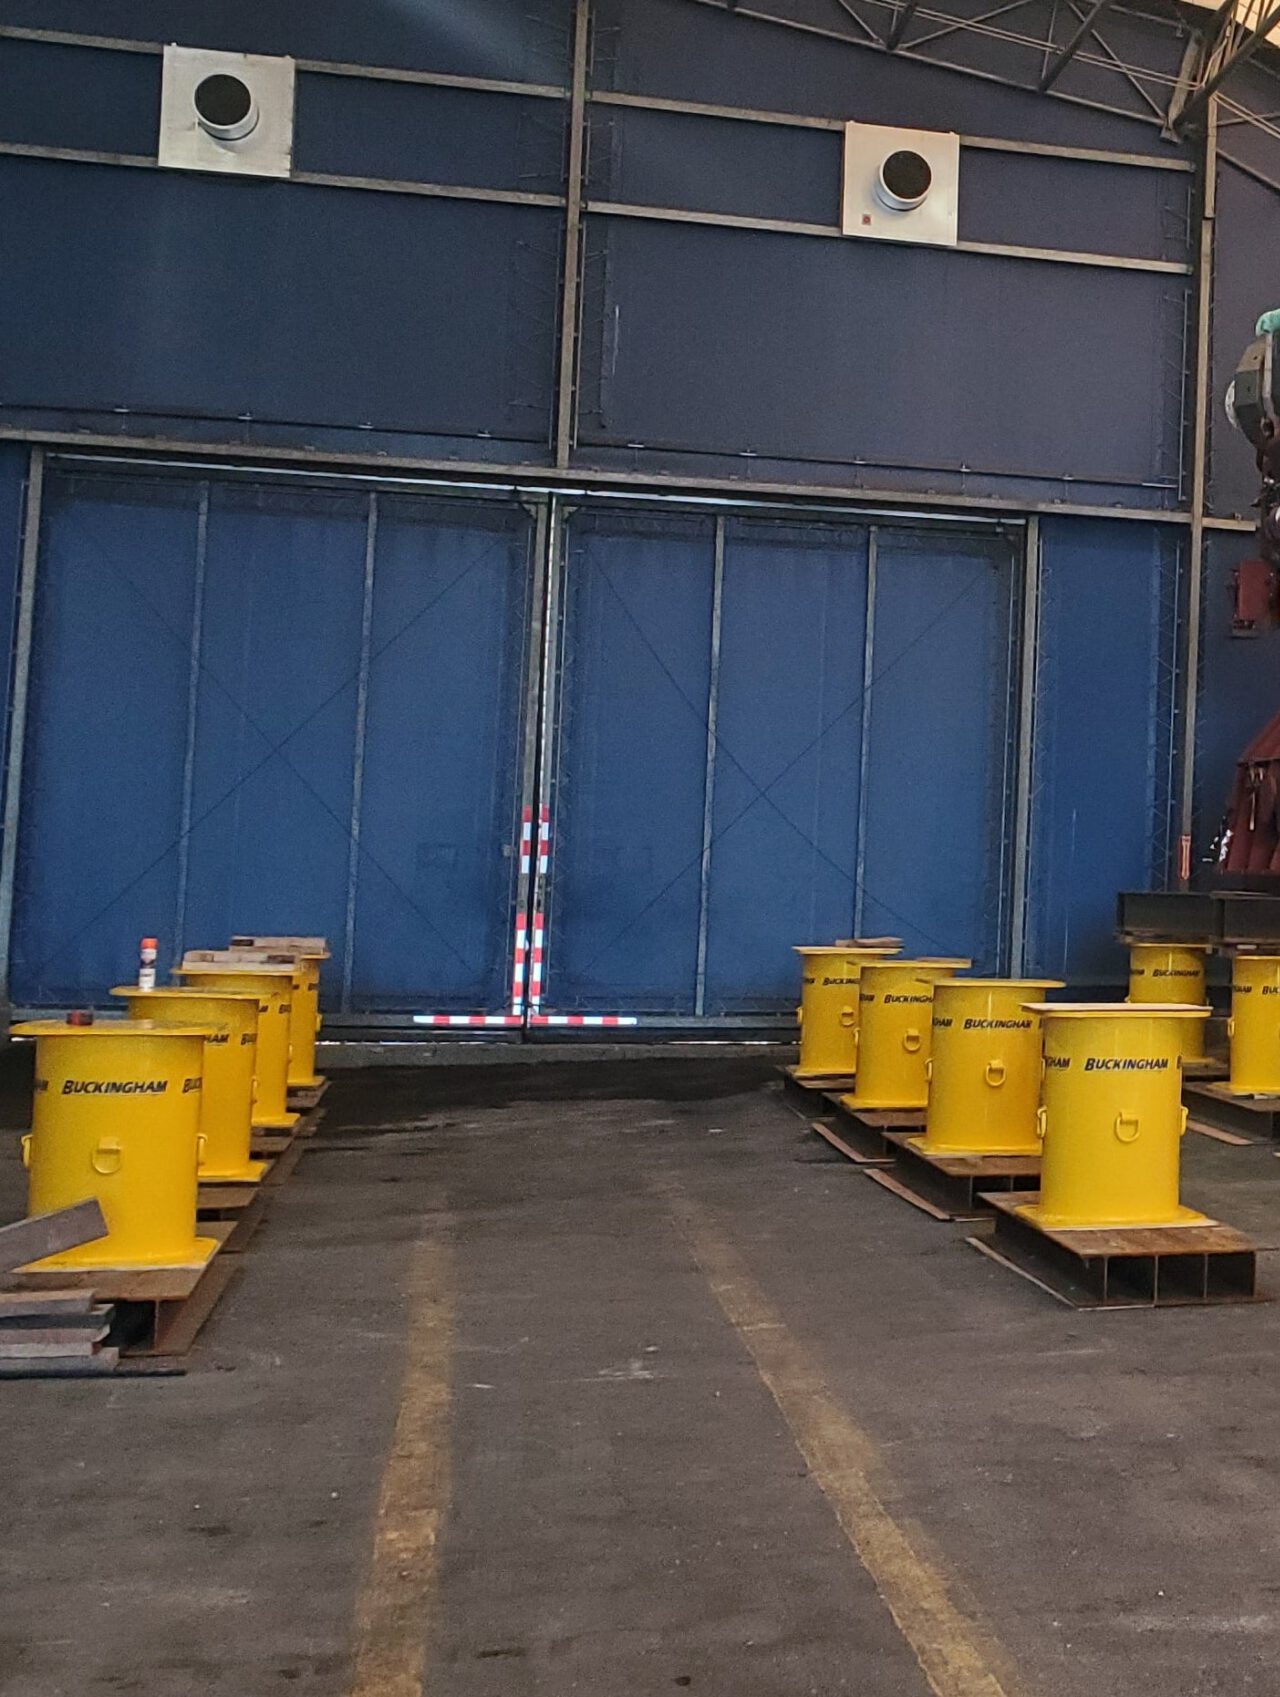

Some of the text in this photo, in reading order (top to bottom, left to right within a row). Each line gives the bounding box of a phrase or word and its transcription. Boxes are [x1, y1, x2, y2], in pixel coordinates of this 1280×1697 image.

[823, 977, 860, 986] BUCKING
[884, 994, 934, 1004] BUCKINGH
[964, 1018, 1032, 1029] BUCKINGHAM
[1085, 1057, 1169, 1071] BUCKINGHAM
[62, 1080, 169, 1095] BUCKINGHAM
